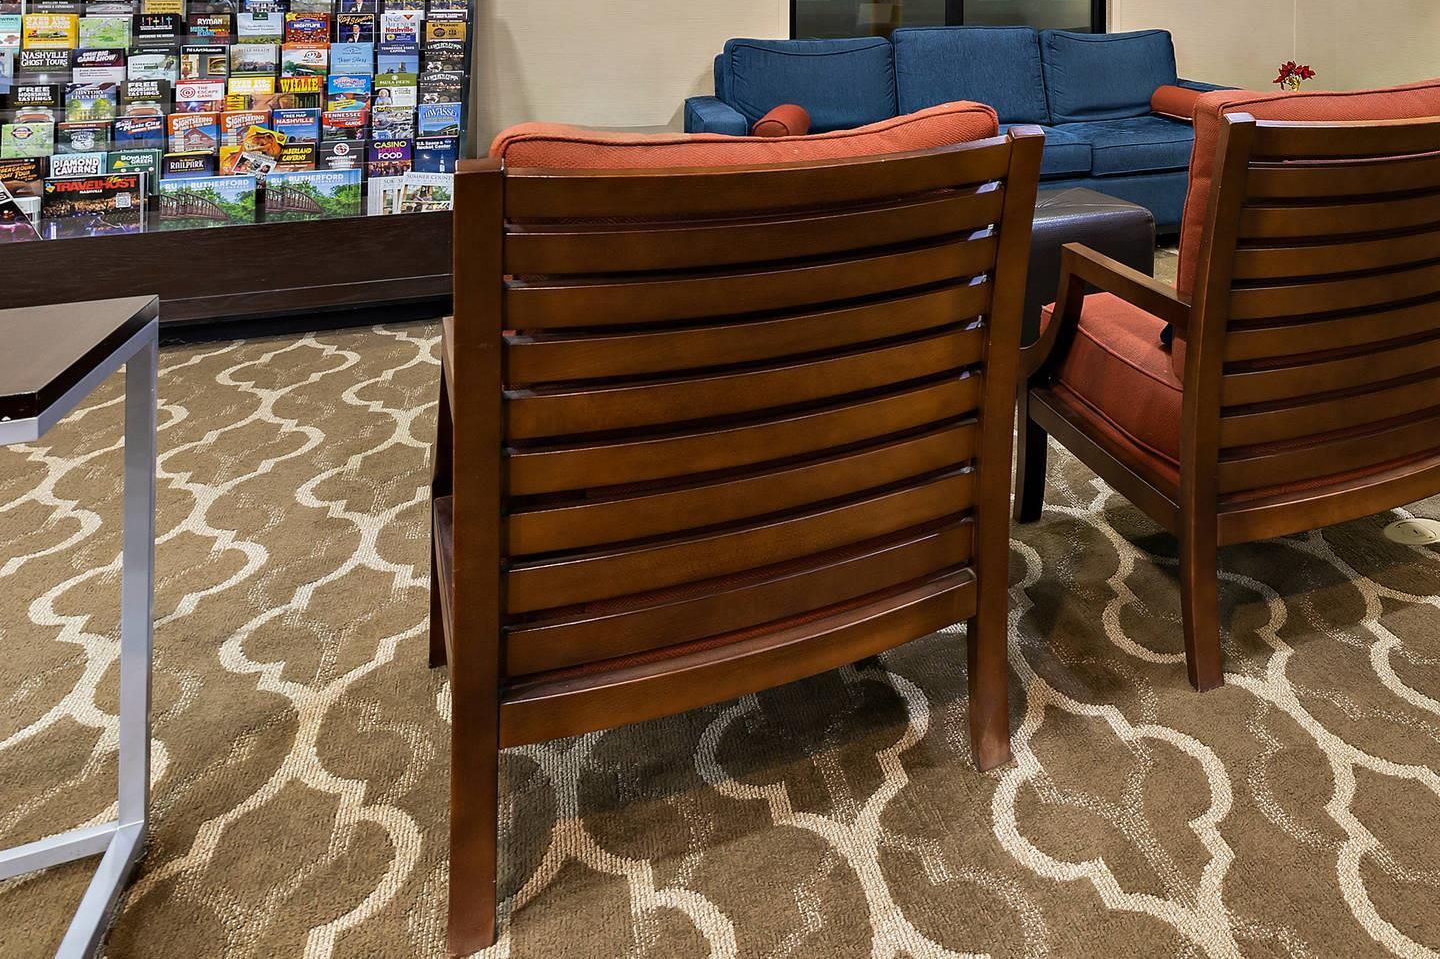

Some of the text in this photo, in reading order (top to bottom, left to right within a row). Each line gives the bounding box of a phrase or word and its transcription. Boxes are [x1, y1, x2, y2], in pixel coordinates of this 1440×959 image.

[21, 51, 68, 59] NASHVILLE
[47, 58, 68, 66] TOURS
[280, 78, 319, 92] WILLIE
[172, 117, 213, 130] SIGHTSEEING
[374, 140, 407, 148] CASINO
[53, 158, 99, 168] DIAMOND
[170, 160, 204, 169] RAILPARK
[55, 165, 97, 175] CAVERNS
[288, 173, 344, 183] RUTHERFORD
[54, 179, 137, 192] TRAVELHOST
[191, 179, 249, 190] RUTHERFORD
